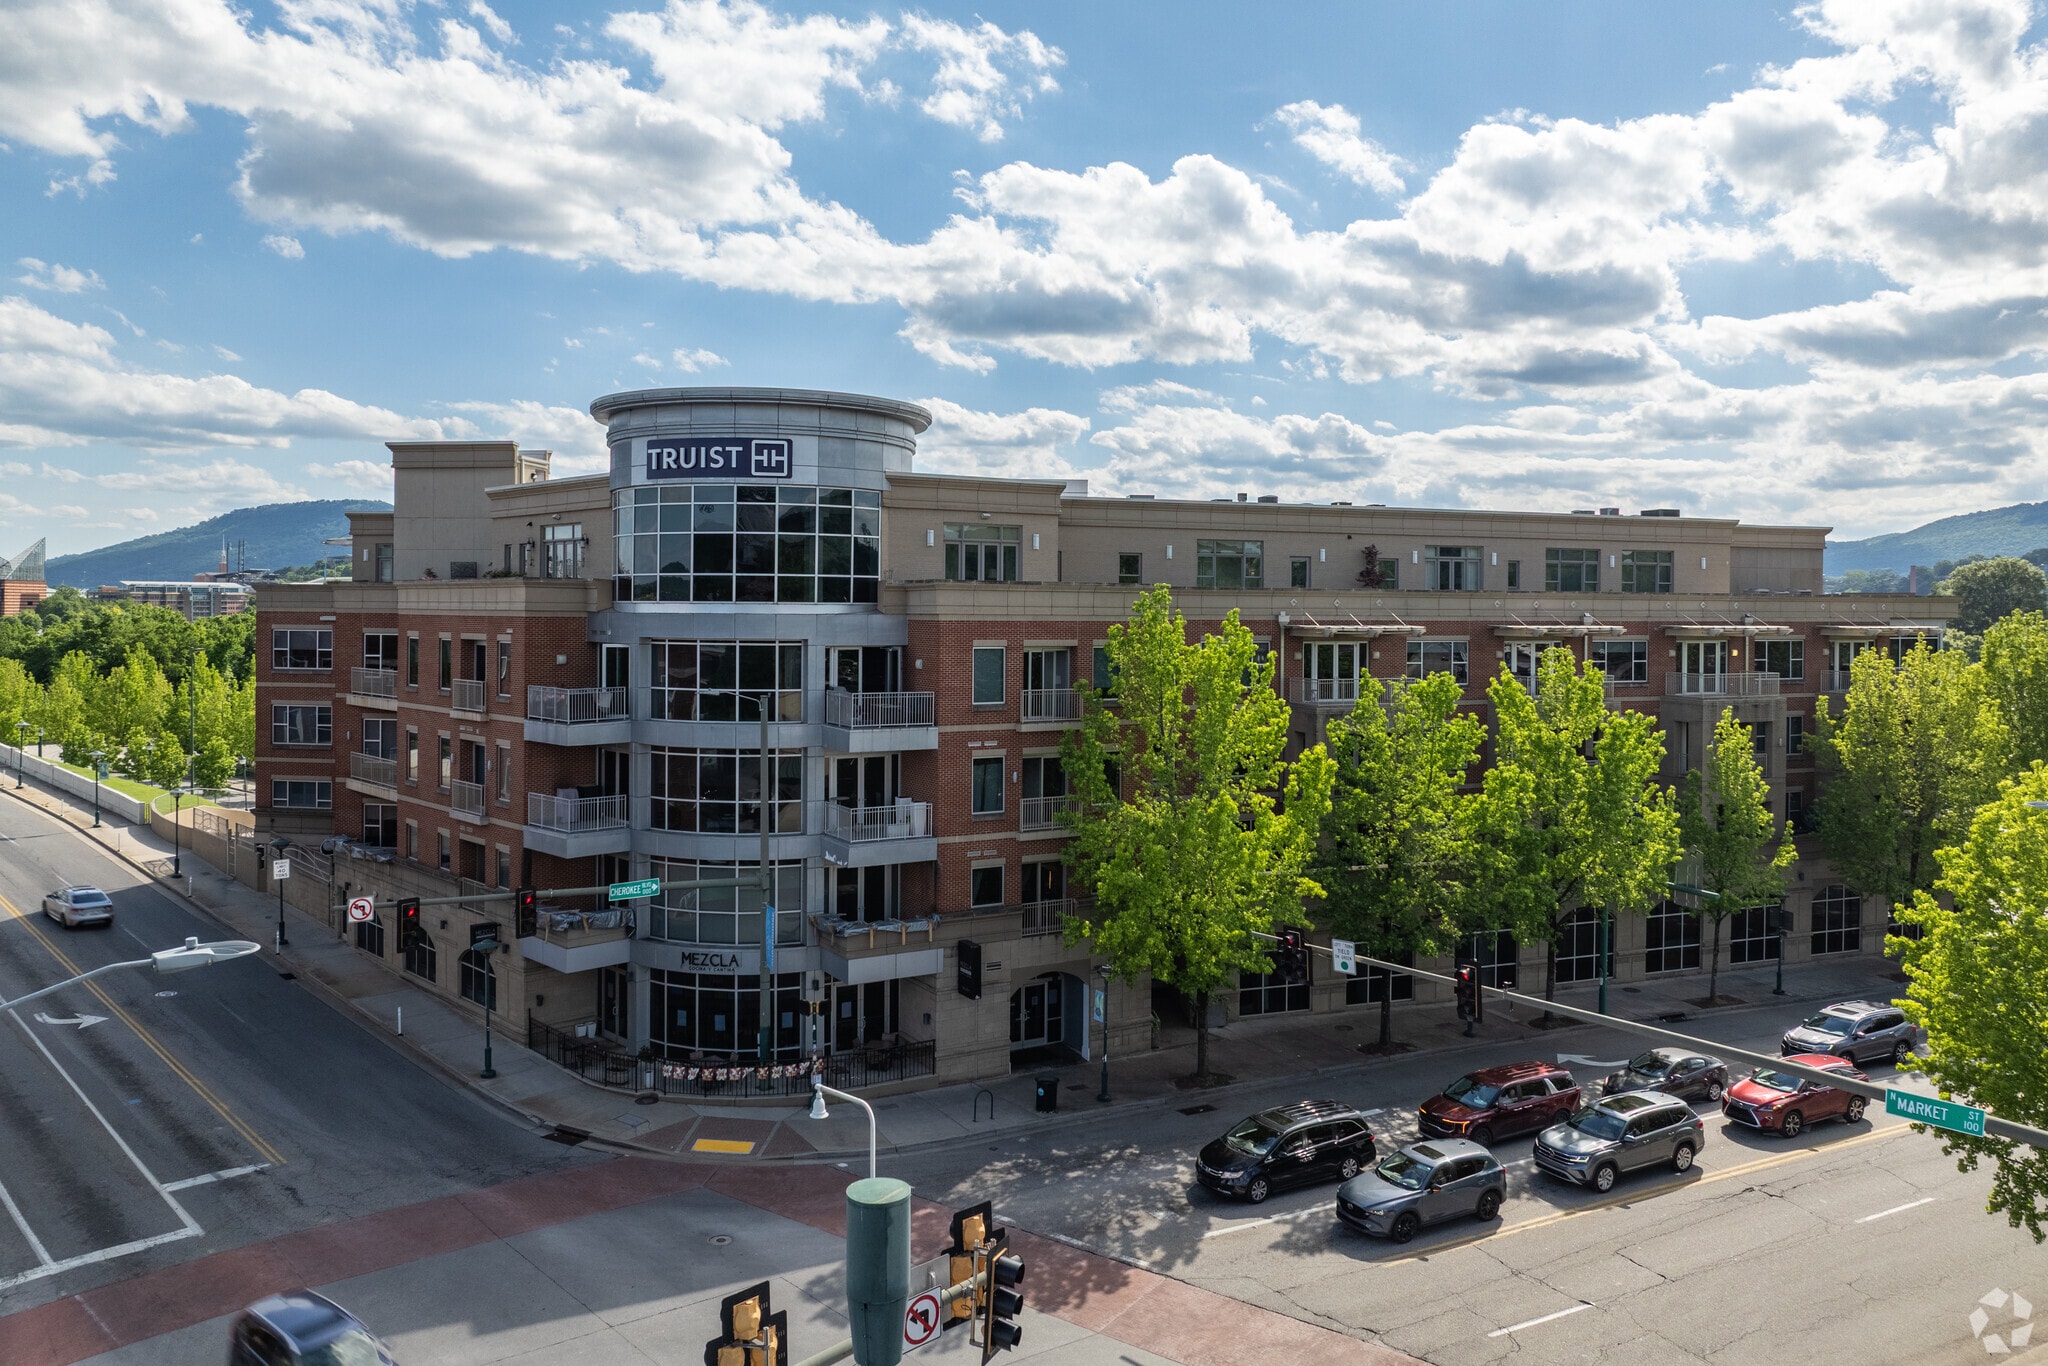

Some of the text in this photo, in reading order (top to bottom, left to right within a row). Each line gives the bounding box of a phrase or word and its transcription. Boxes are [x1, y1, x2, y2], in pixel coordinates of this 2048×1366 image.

[648, 446, 743, 470] TRUIST
[611, 885, 641, 896] CHEROKEE
[681, 951, 739, 967] MEZCLA
[1890, 1091, 1980, 1121] N MARKET ST
[1963, 1121, 1979, 1132] 100
